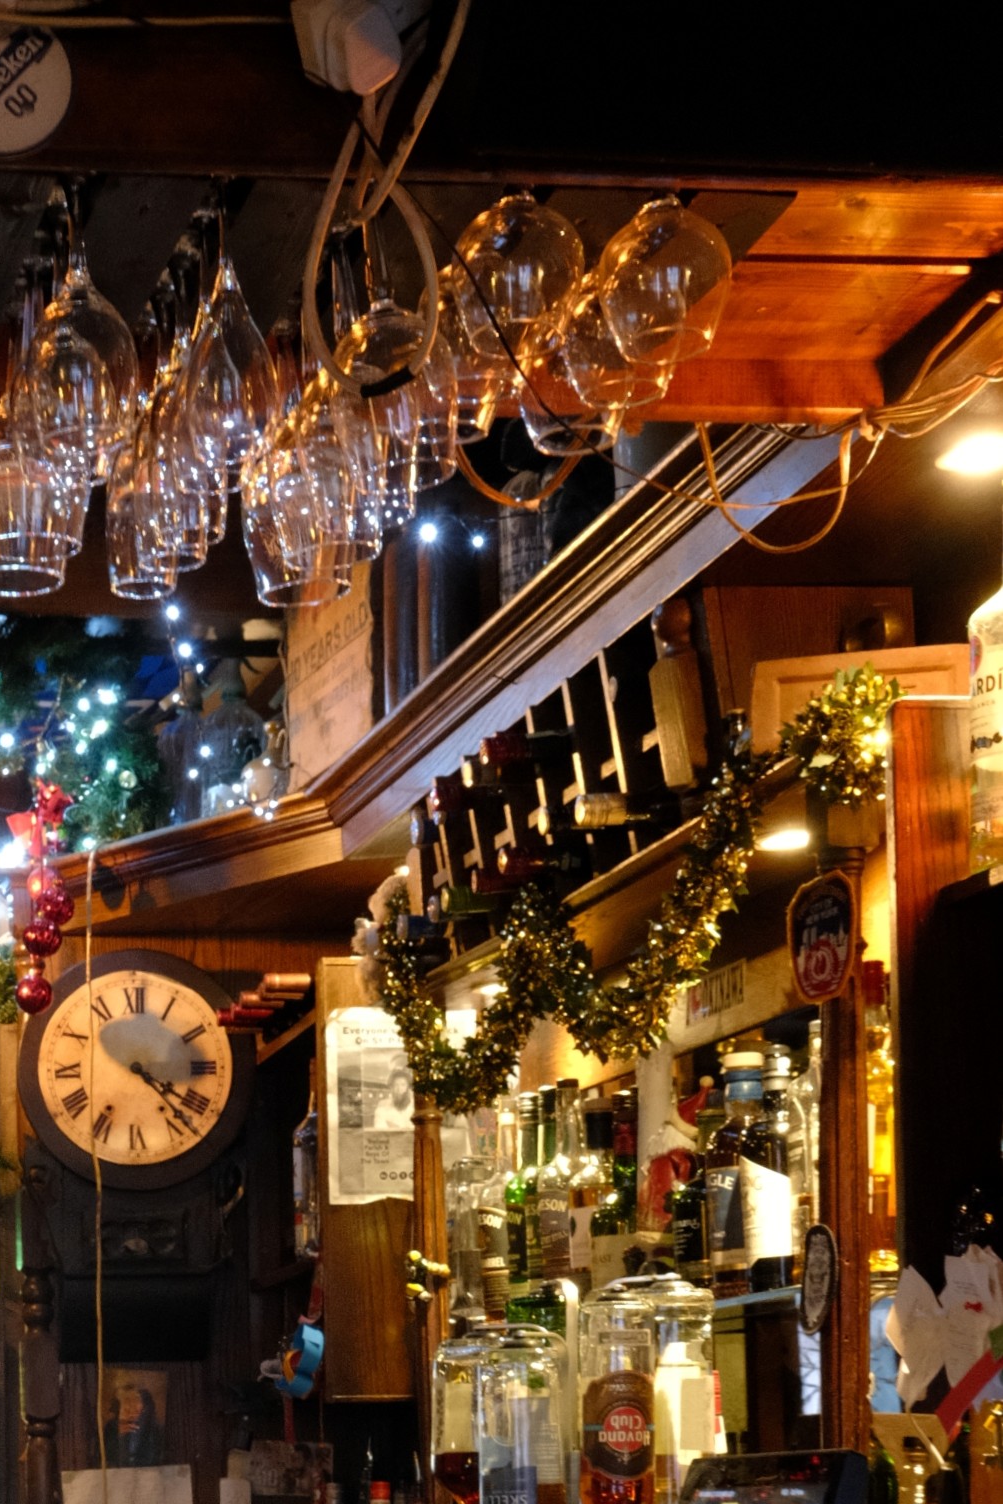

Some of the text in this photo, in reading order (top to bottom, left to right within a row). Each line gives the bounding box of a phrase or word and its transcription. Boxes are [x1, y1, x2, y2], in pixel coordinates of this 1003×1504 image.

[302, 622, 342, 673] YEARS
[343, 603, 369, 640] OLD
[610, 1415, 642, 1430] Club
[598, 1431, 651, 1446] Havana
